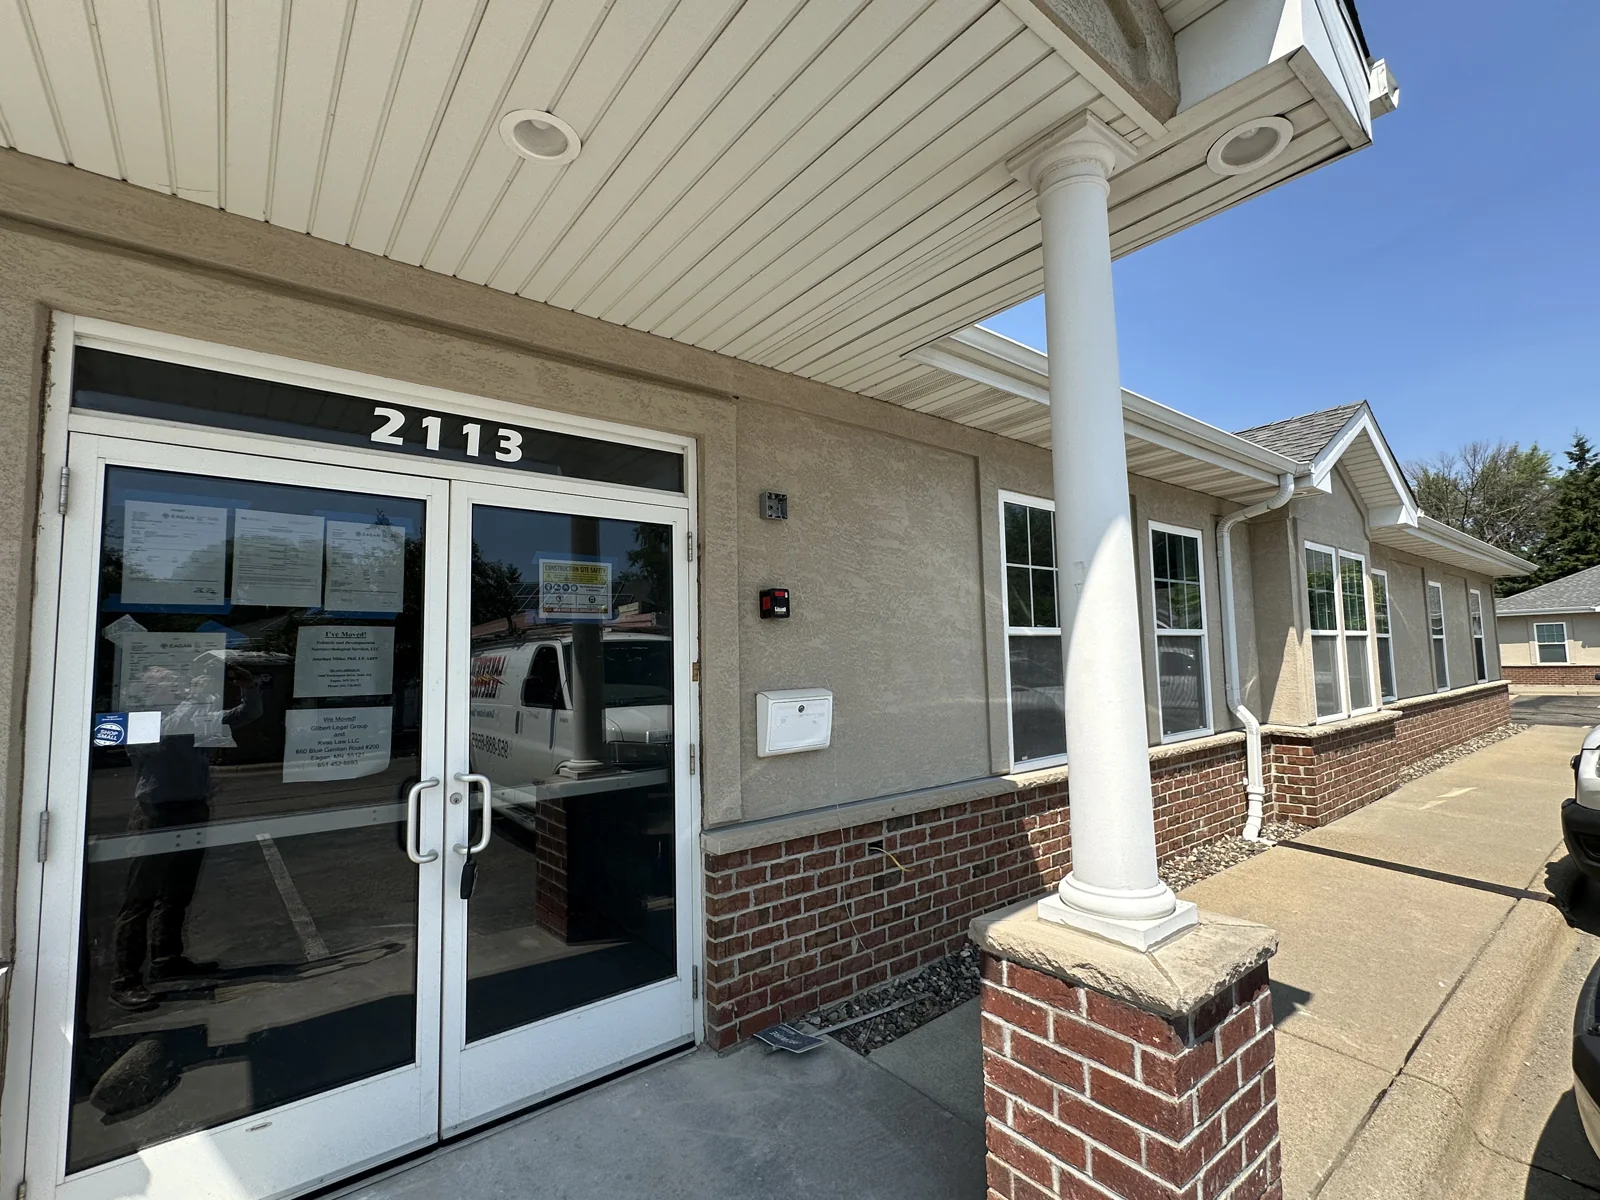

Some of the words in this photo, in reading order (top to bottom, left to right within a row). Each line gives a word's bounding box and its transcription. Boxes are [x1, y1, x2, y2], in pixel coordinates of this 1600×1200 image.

[371, 407, 523, 463] 2113
[545, 565, 579, 573] CONSTRUCTION
[97, 733, 118, 741] SMALL
